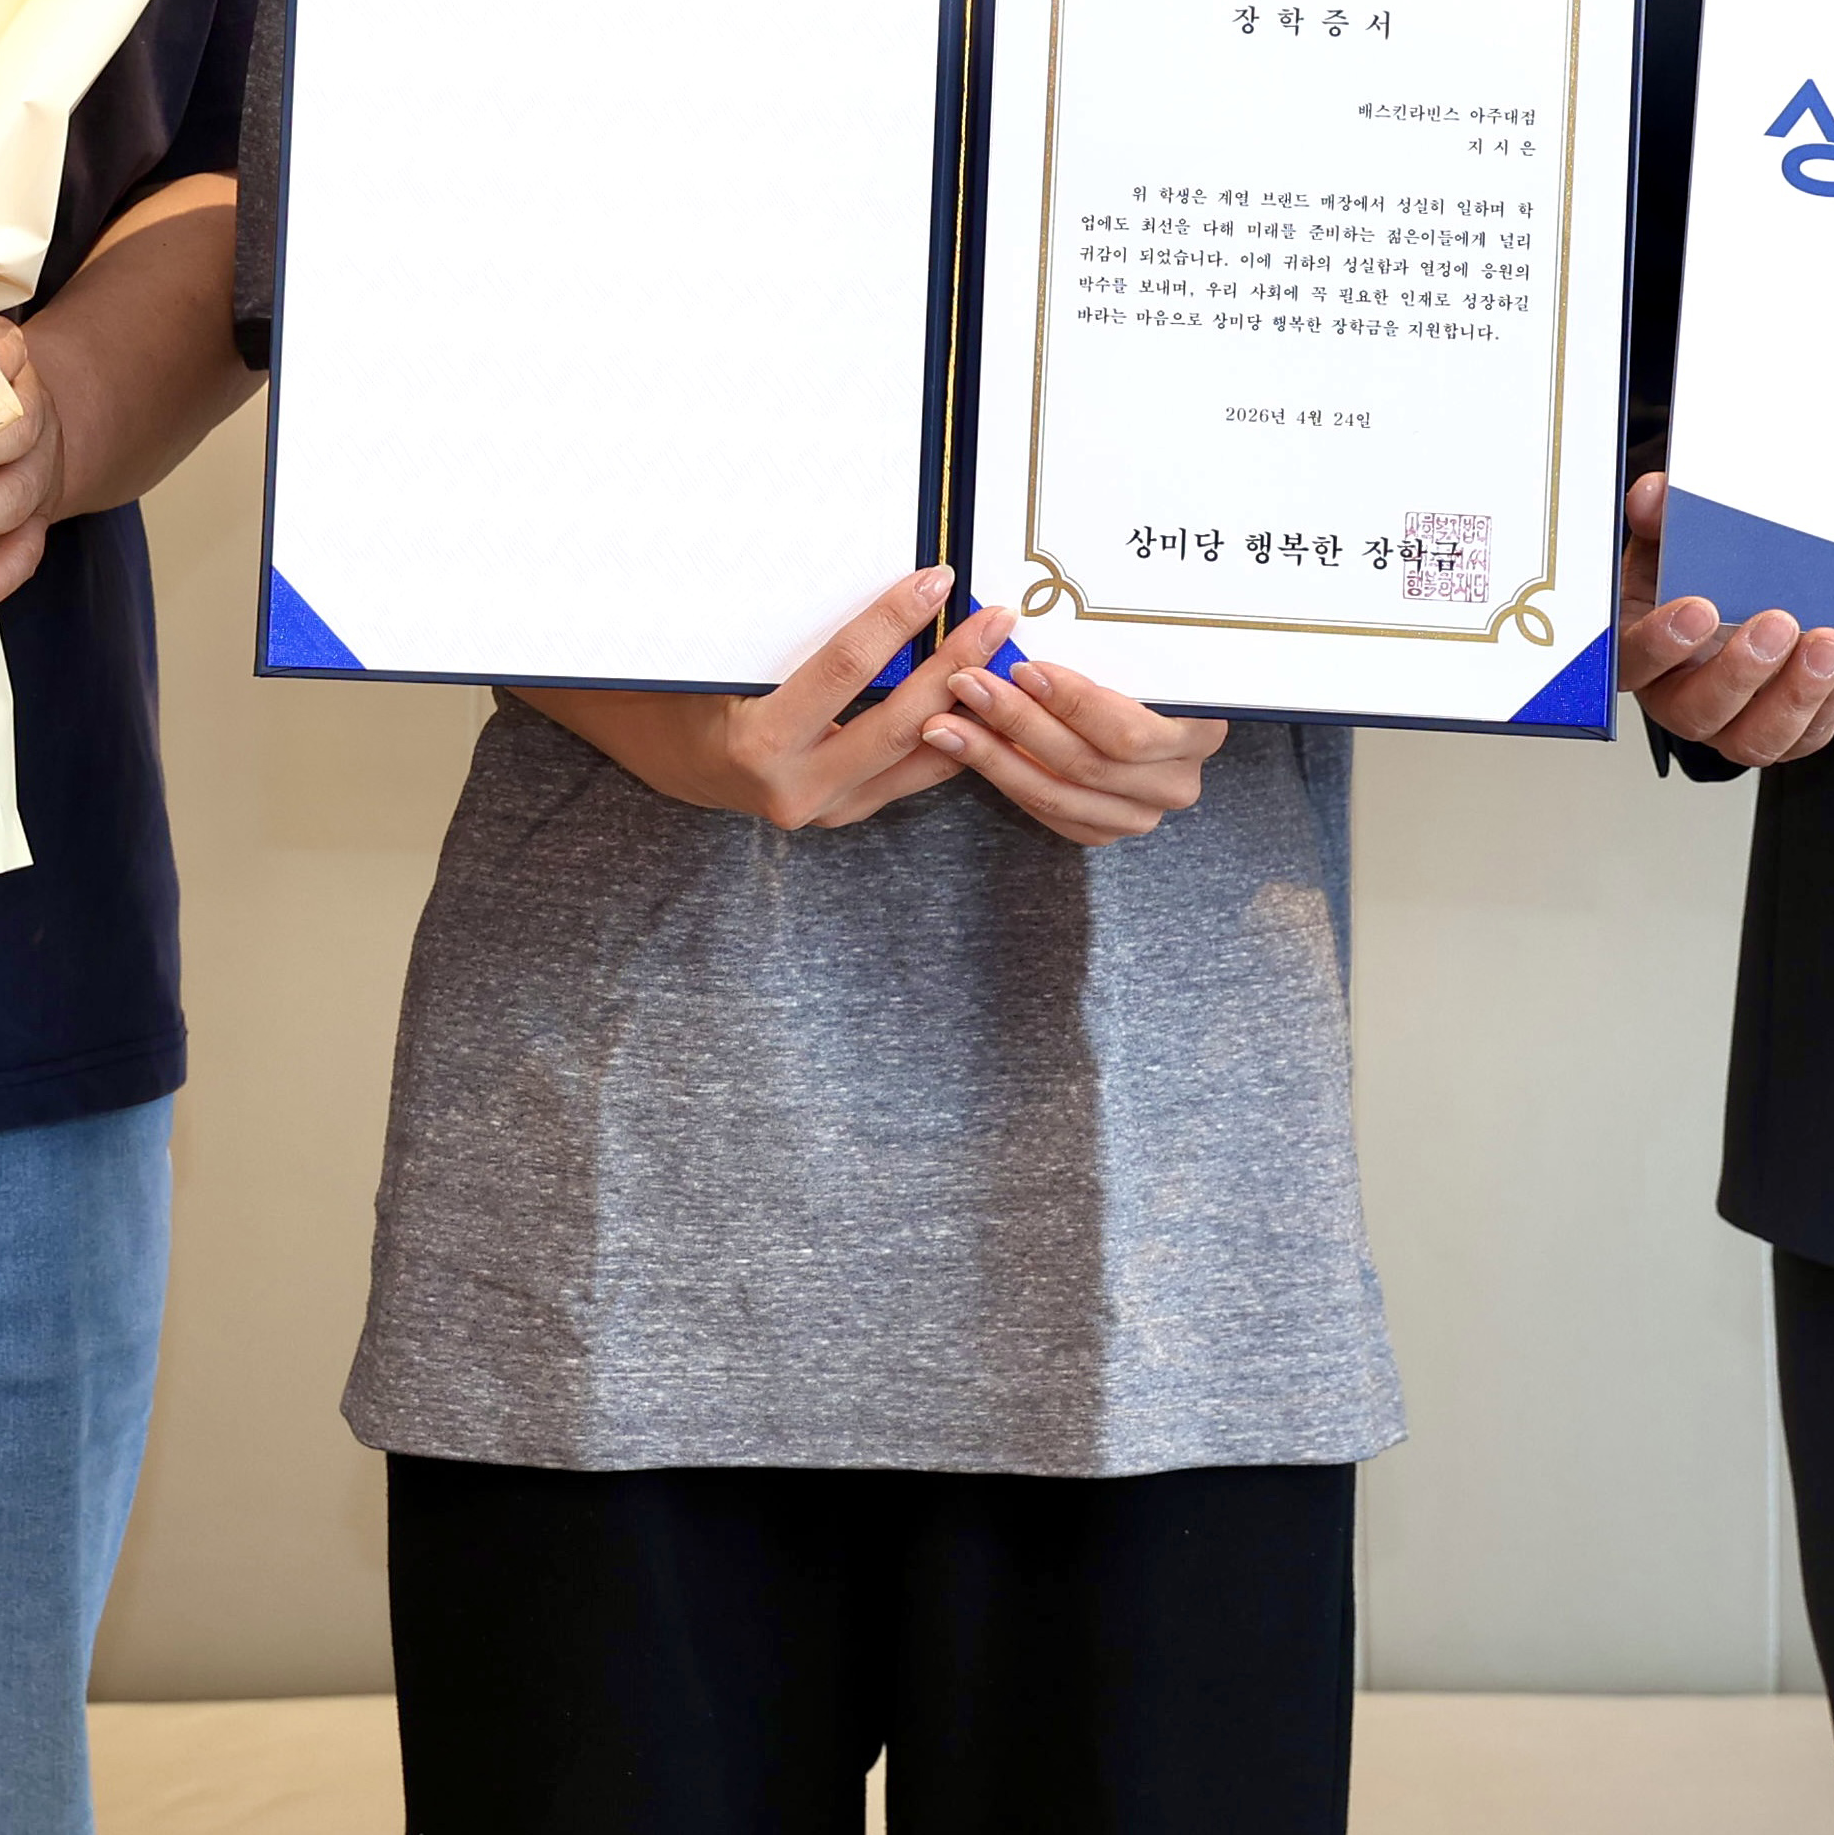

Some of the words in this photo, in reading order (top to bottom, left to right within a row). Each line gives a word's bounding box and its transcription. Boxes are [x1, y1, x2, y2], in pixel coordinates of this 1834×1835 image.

[1358, 102, 1460, 123] 배스킨라빈스
[1470, 106, 1535, 126] 아주대점
[1132, 185, 1147, 203] 위
[1159, 186, 1208, 205] 학생은
[1219, 189, 1249, 207] 계열
[1261, 191, 1310, 209] 브랜드
[1320, 193, 1385, 213] 매장에서
[1397, 196, 1444, 216] 성실히
[1457, 199, 1504, 218] 일하며
[1518, 201, 1534, 219] 학
[1081, 214, 1130, 232] 업에도
[1141, 217, 1191, 236] 최선을
[1203, 219, 1234, 238] 다해
[1247, 221, 1297, 240] 미래를
[1309, 224, 1375, 243] 준비하는
[1388, 227, 1486, 248] 젊은이들에게
[1500, 232, 1531, 250] 널리
[1079, 245, 1127, 264] 귀감이
[1139, 247, 1228, 268] 되었습니다.
[1240, 251, 1271, 270] 이에
[1283, 253, 1331, 272] 귀하의
[1420, 259, 1469, 278] 열정에
[1481, 262, 1530, 281] 응원의
[1079, 275, 1128, 294] 박수를
[1139, 278, 1194, 297] 보내며,
[1206, 281, 1237, 299] 우리
[1251, 282, 1299, 302] 사회에
[1311, 286, 1328, 303] 꼭
[1339, 287, 1389, 306] 필요한
[1400, 289, 1451, 308] 인재로
[1462, 292, 1529, 312] 성장하길
[1077, 306, 1127, 325] 바라는
[1136, 308, 1203, 327] 마음으로
[1212, 312, 1262, 332] 상미당
[1272, 315, 1322, 334] 행복한
[1332, 317, 1399, 337] 장학금을
[1409, 321, 1499, 342] 지원합니다.
[1225, 406, 1286, 425] 2026년
[1296, 409, 1323, 427] 4월
[1333, 411, 1371, 429] 24일
[1126, 525, 1225, 562] 상미당
[1245, 531, 1343, 567] 행복한
[1362, 536, 1464, 573] 장학금
